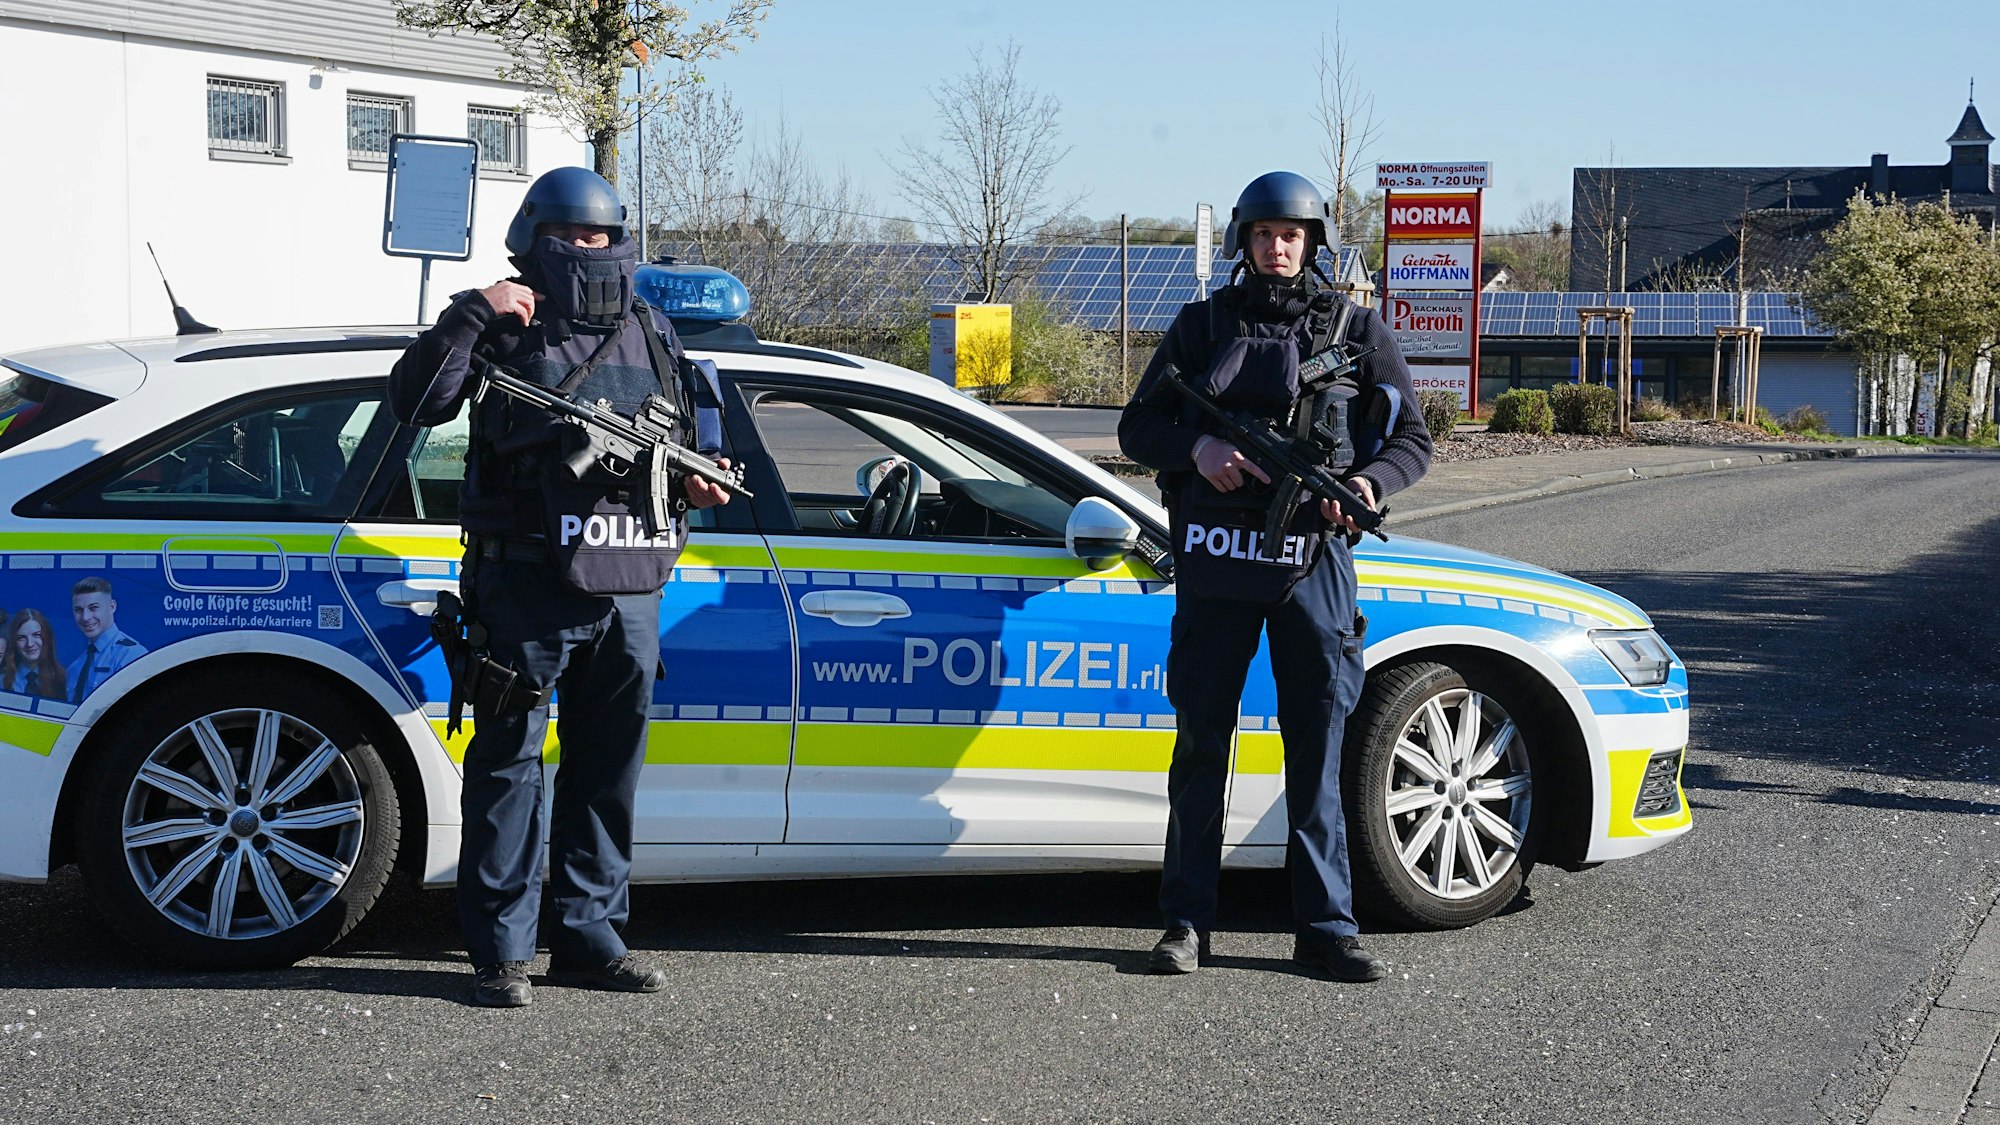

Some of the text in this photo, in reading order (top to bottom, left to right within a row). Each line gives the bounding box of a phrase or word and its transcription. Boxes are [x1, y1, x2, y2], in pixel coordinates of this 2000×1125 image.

[1378, 162, 1485, 175] NORMA Öffnungszeiten
[1463, 175, 1485, 186] Uhr
[1391, 206, 1472, 225] NORMA
[1402, 253, 1458, 267] Getränke
[1390, 267, 1469, 280] HOFFMANN
[1414, 305, 1463, 313] BACKHAUS
[1392, 300, 1464, 332] Pieroth
[1417, 344, 1429, 352] der
[1431, 341, 1462, 351] Heimat!
[1412, 377, 1466, 389] BRÖKER
[163, 594, 312, 613] Coole Köpfe gesucht!
[164, 614, 312, 628] www.polizei.rlp.de/karriere
